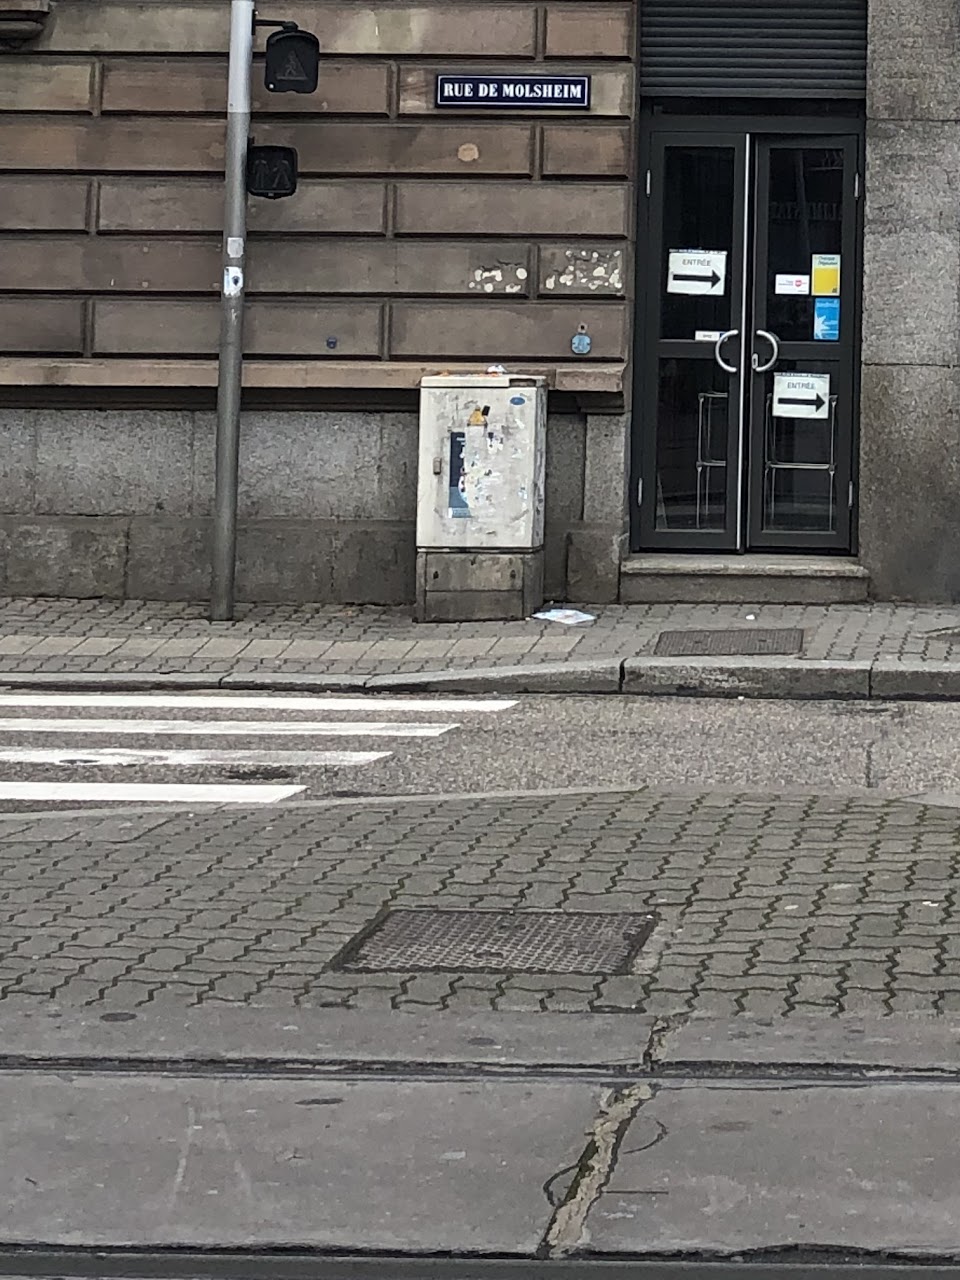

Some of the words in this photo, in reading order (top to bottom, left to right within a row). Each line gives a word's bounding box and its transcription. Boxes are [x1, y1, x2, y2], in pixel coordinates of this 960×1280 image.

[443, 82, 473, 97] RUE
[478, 83, 498, 97] DE
[502, 84, 582, 98] MOLSHEIM
[682, 257, 712, 267] ENTRÉE
[787, 381, 816, 390] ENTRÉE
